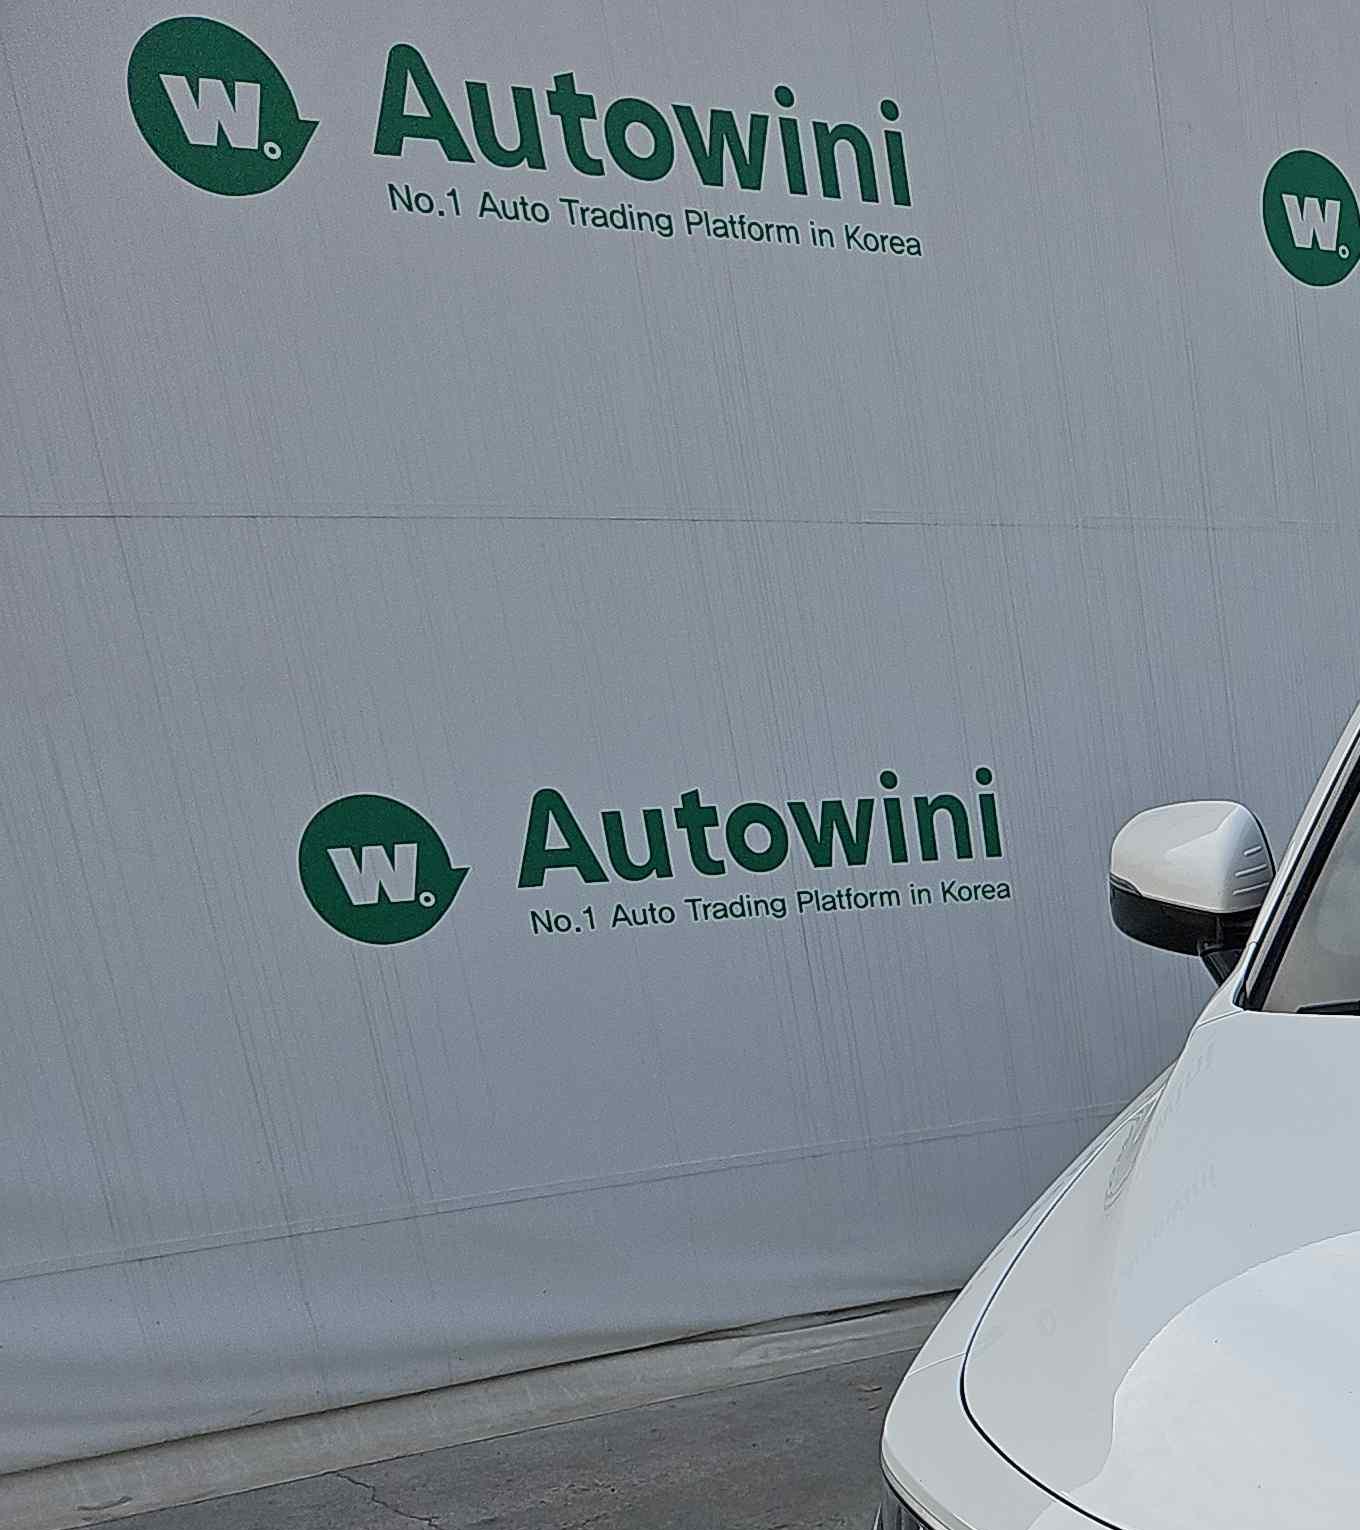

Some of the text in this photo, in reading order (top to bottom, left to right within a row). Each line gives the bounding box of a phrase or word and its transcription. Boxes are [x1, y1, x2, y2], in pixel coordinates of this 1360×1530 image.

[373, 42, 913, 208] Autowini
[387, 183, 924, 257] No.1 Auto Trading Platform in Korea
[518, 766, 1003, 889] Autowini
[530, 880, 1011, 936] No.1 Auto Trading Platform in Korea
